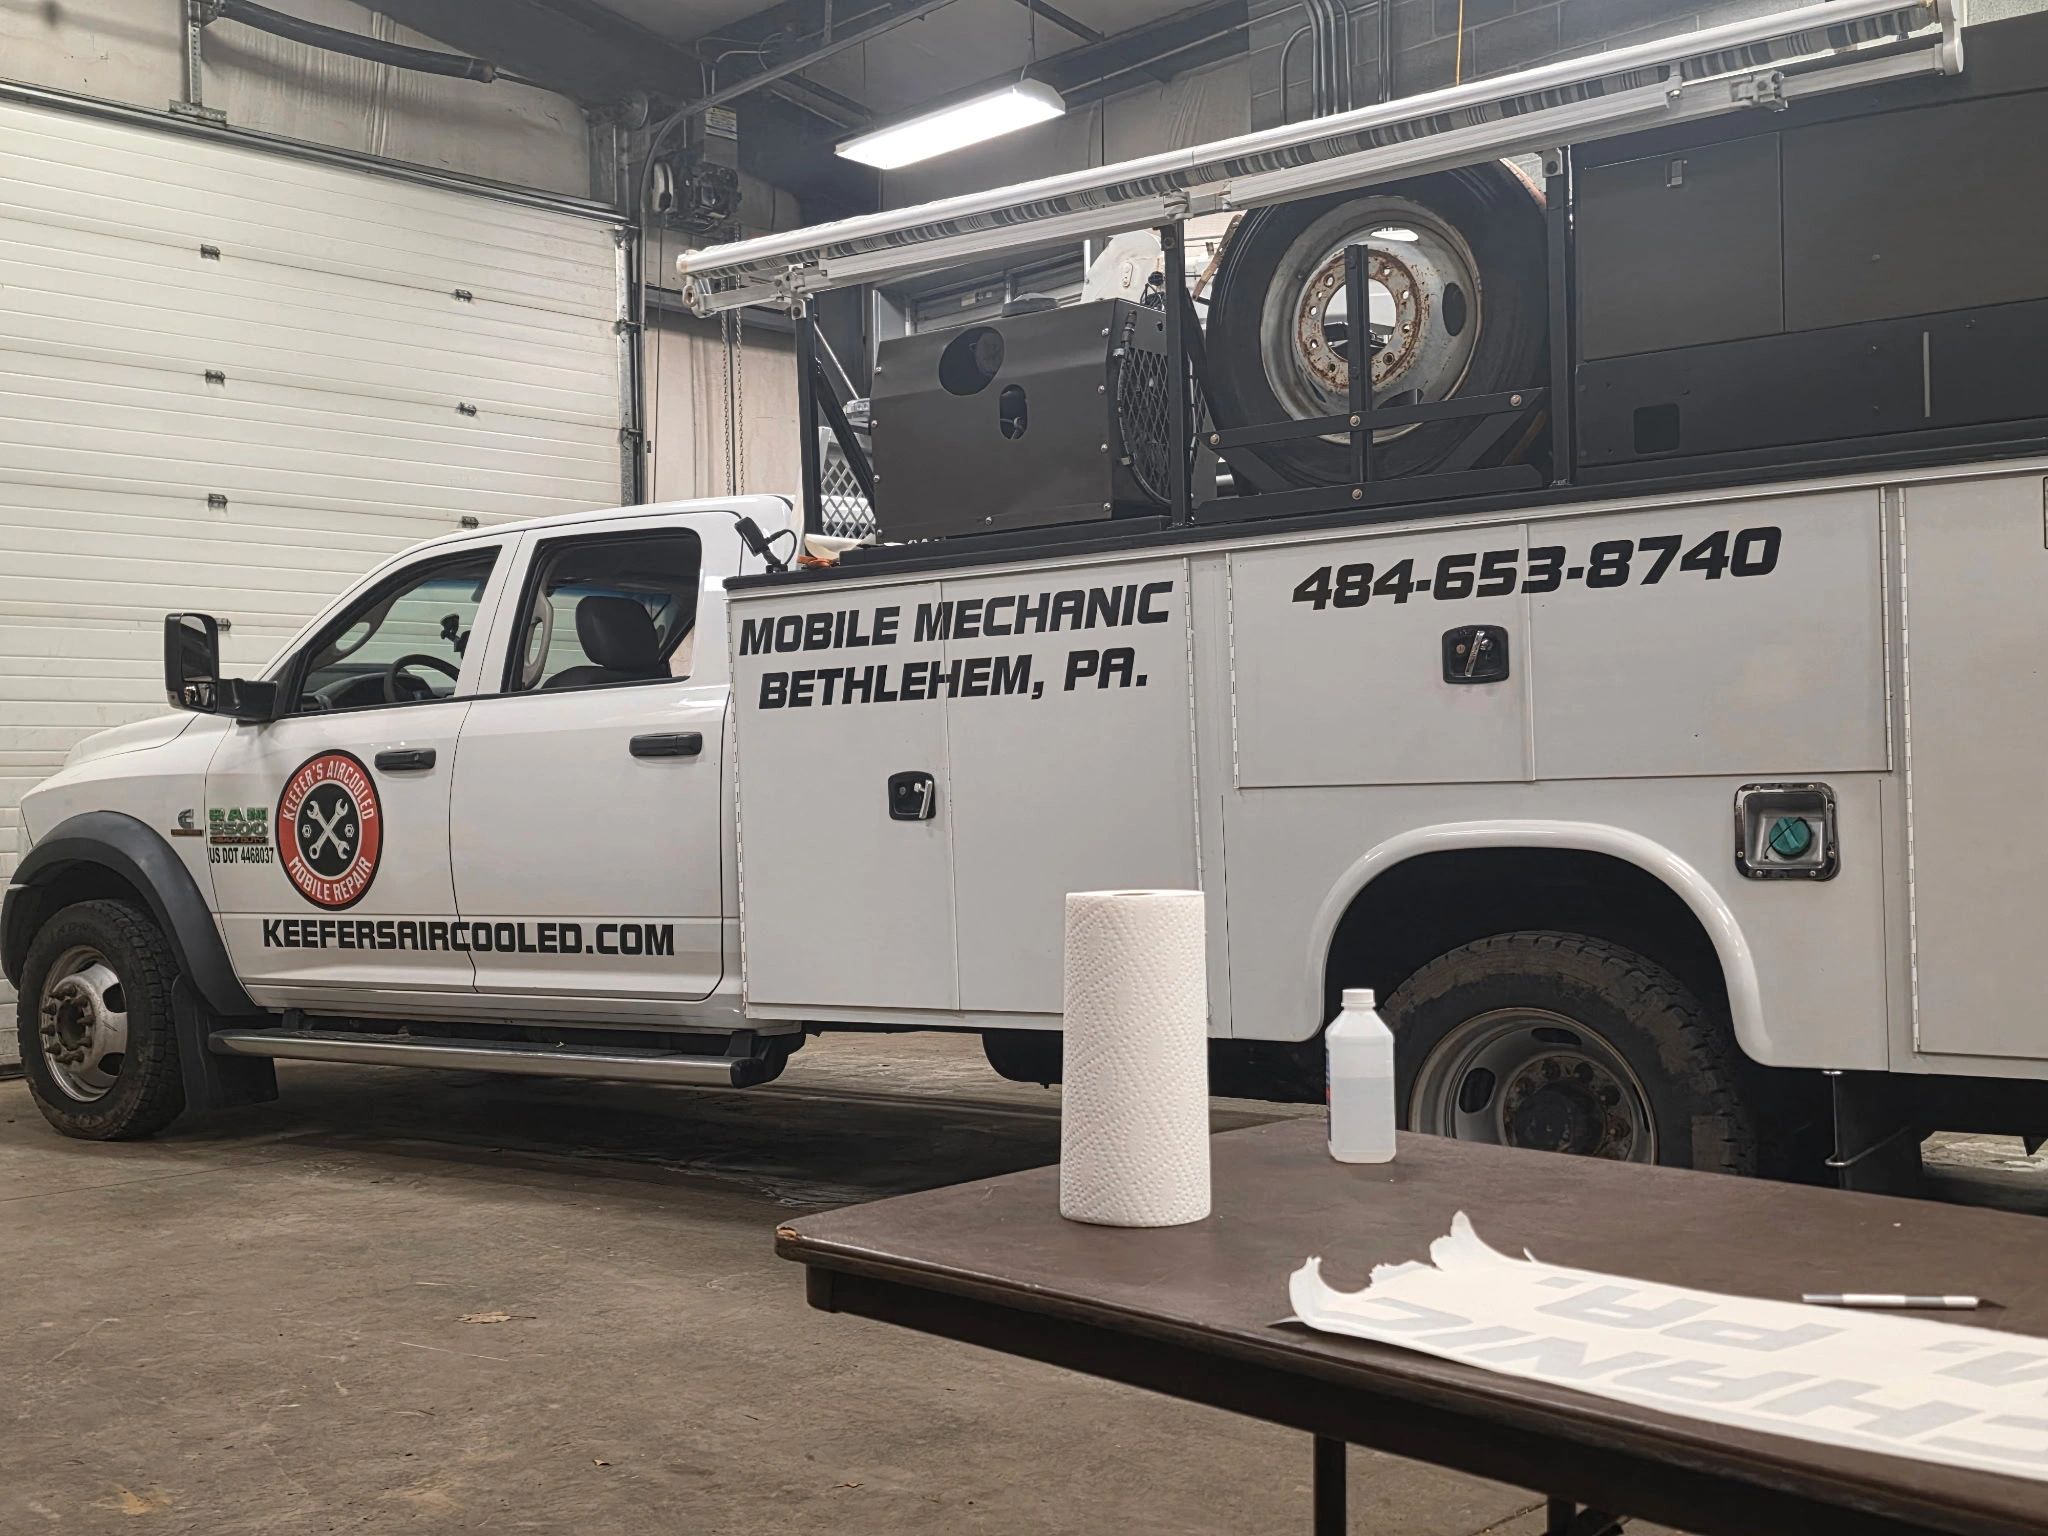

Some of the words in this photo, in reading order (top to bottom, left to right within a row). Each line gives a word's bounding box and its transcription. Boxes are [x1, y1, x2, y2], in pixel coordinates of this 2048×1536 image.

[1292, 526, 1782, 611] 484-653-8740
[739, 605, 901, 656] MOBILE
[913, 580, 1174, 643] MECHANIC
[759, 654, 1044, 710] BETHLEHEM,
[1063, 646, 1148, 692] PA.
[209, 807, 269, 821] RAM
[282, 763, 323, 821] KEEFER'S
[326, 760, 375, 820] AIRCOOLED
[209, 847, 221, 864] US
[222, 847, 239, 864] DOT
[240, 846, 274, 864] 4468037
[288, 856, 331, 901] MOBILE
[333, 856, 372, 901] REPAIR
[262, 918, 675, 956] KEEFERSAIRCOOLED.COM
